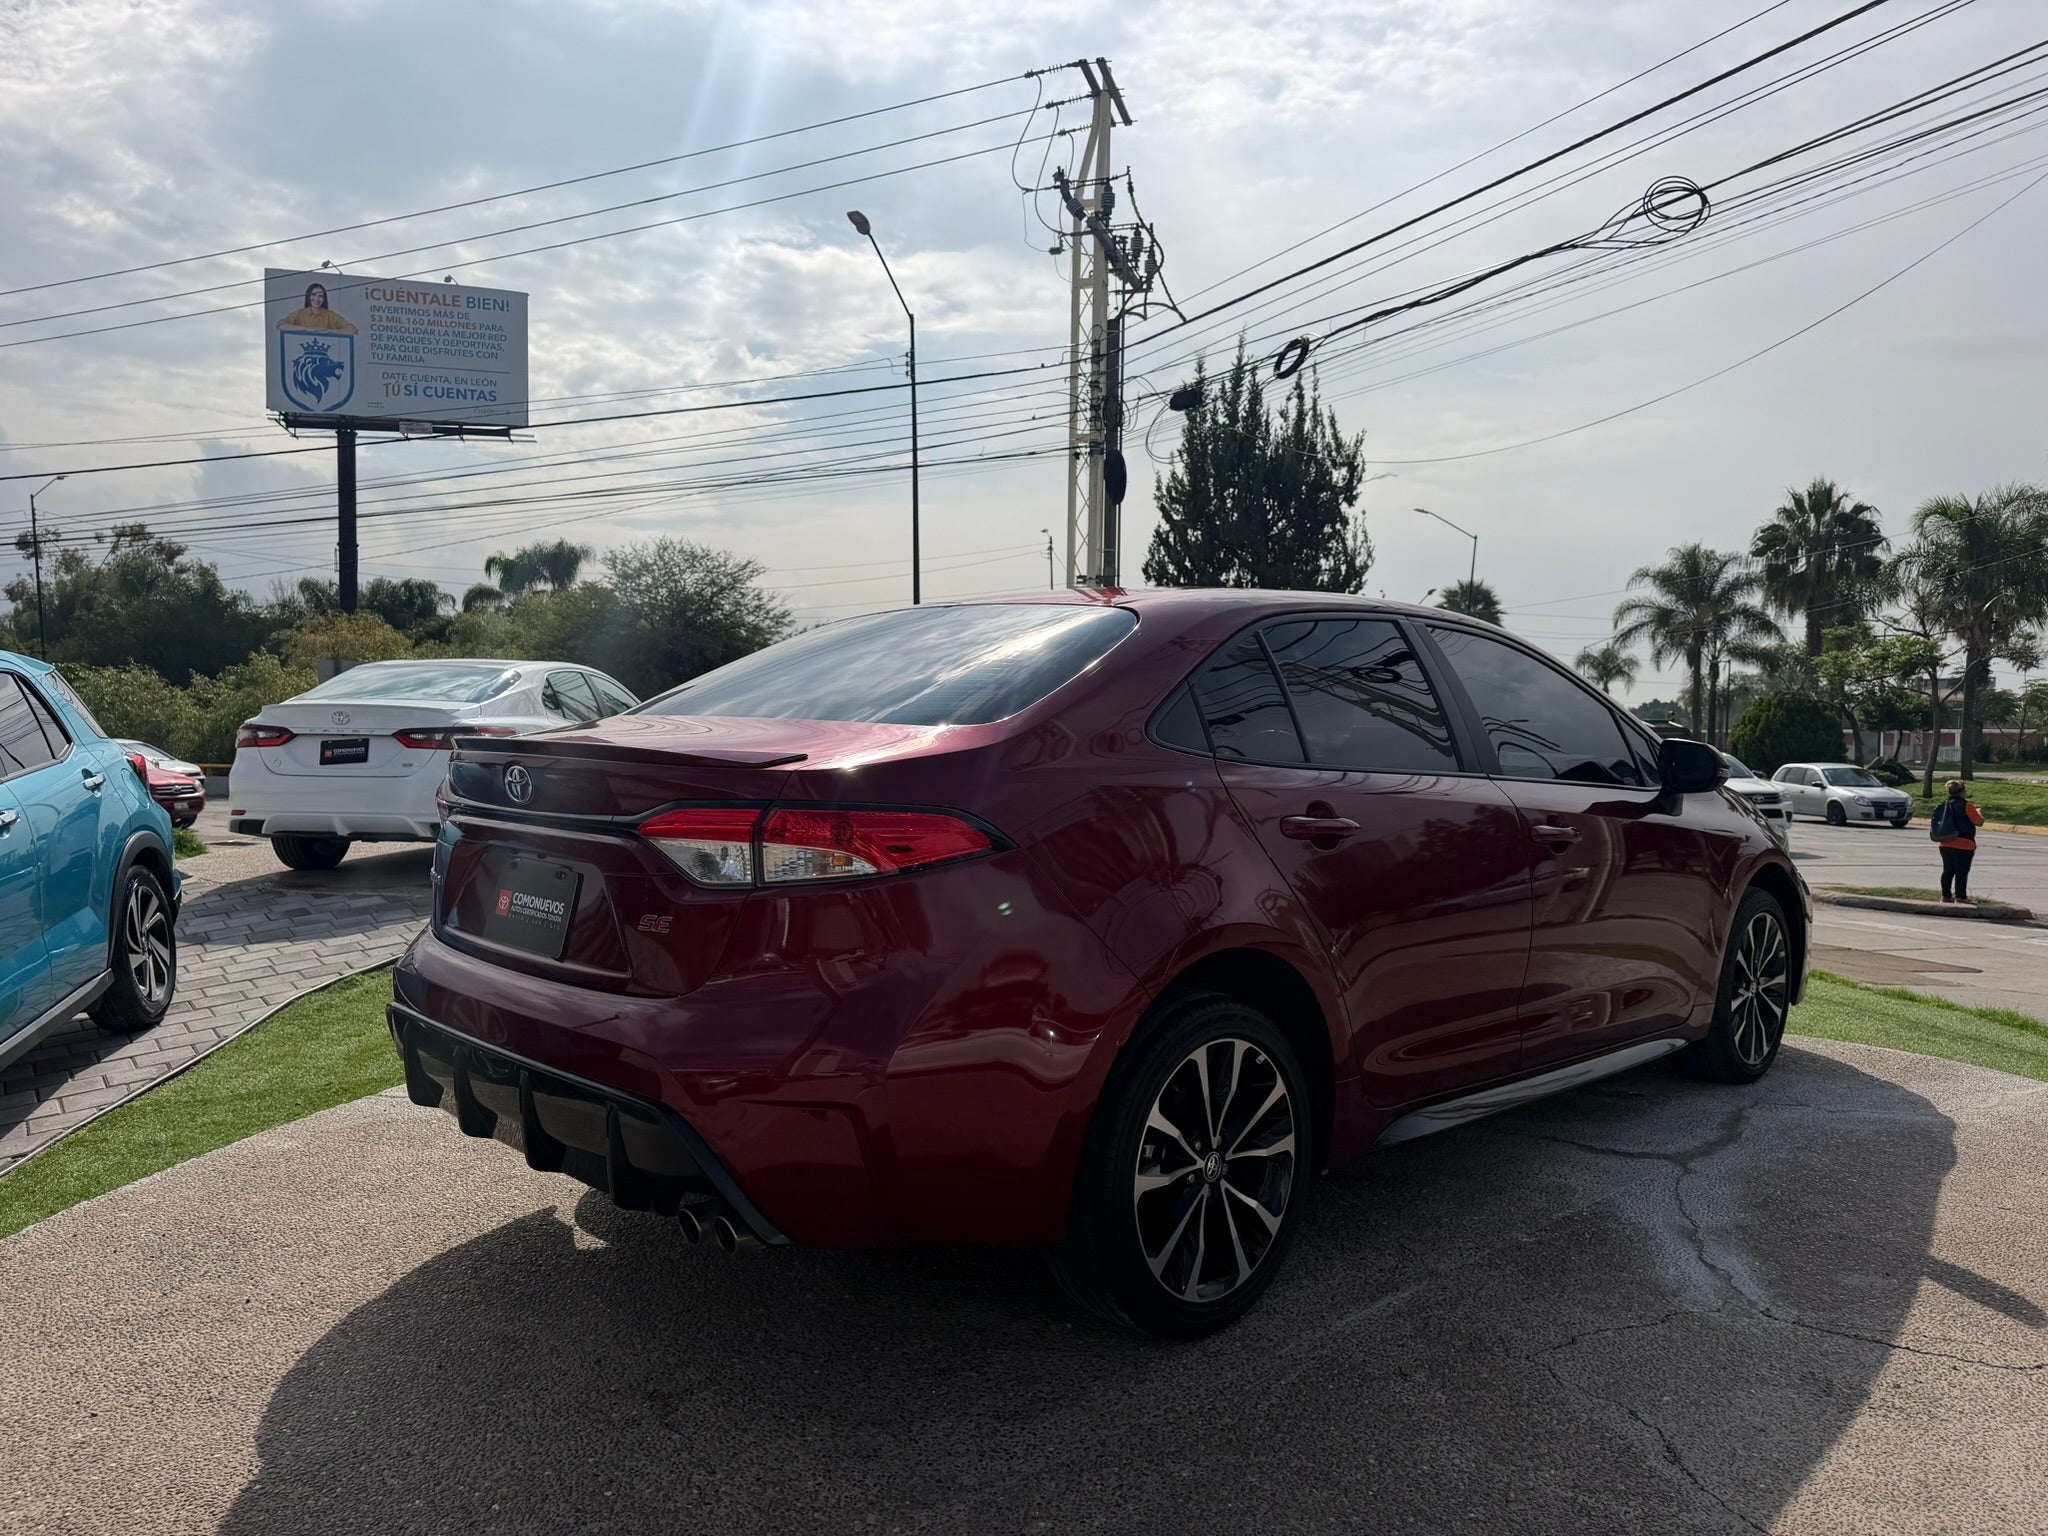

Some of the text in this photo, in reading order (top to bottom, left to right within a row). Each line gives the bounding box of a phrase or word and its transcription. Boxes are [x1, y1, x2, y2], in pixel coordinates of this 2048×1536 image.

[365, 287, 510, 312] ¡CUÉNTALE BIEN!
[370, 304, 470, 320] INVERTIMOS MÁS DE
[370, 324, 508, 342] CONSOLIDAR LA MEJOR RED
[386, 315, 404, 324] MIL
[407, 317, 425, 326] 160
[427, 318, 477, 330] MILLONES
[479, 323, 504, 333] PARA
[370, 332, 505, 352] DE PARQUES Y DEPORTIVAS,
[371, 342, 498, 360] PARA QUE DISFRUTES CON
[372, 352, 425, 364] TU FAMILIA
[382, 372, 408, 380] DATE
[470, 377, 497, 387] LEÓN
[383, 380, 496, 402] TÚ SÍ CUENTAS
[512, 892, 565, 915] COMONUEVOS
[637, 914, 673, 934] SE
